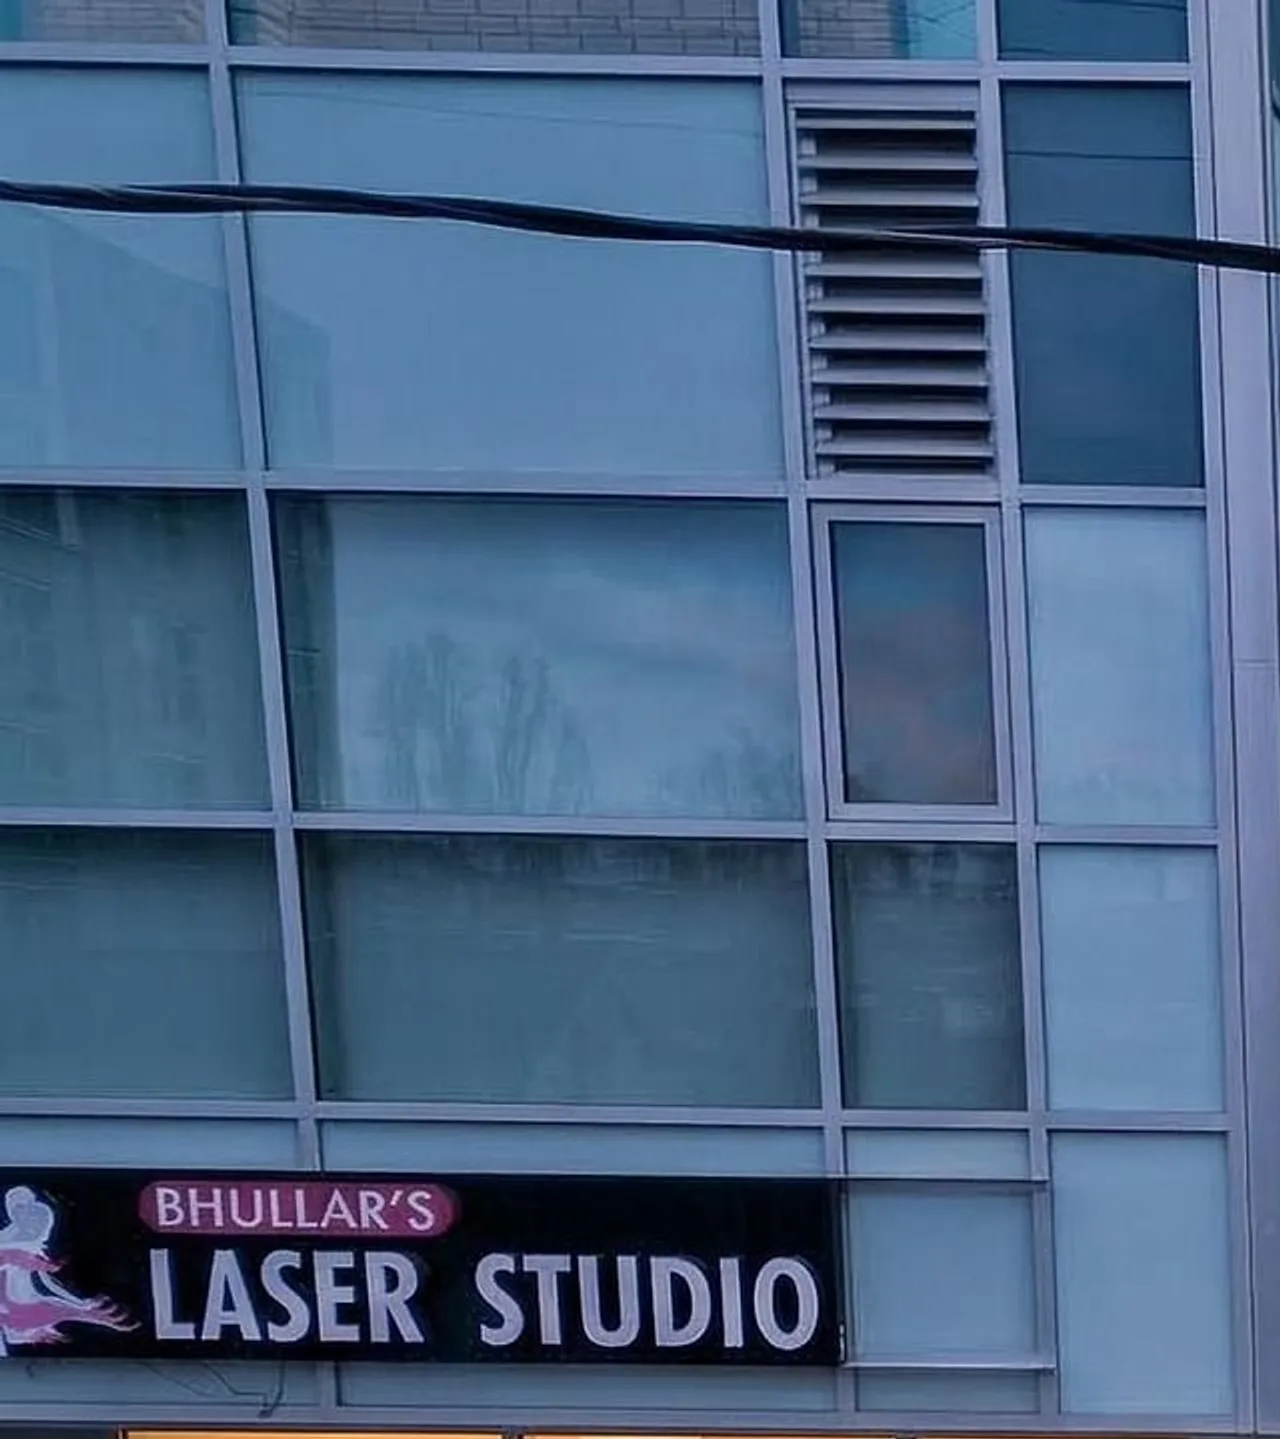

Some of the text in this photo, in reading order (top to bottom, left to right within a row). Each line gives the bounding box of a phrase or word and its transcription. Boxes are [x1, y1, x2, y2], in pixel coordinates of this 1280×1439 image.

[155, 1187, 434, 1232] BHULLAR'S
[150, 1249, 819, 1350] LASER STUDIO
